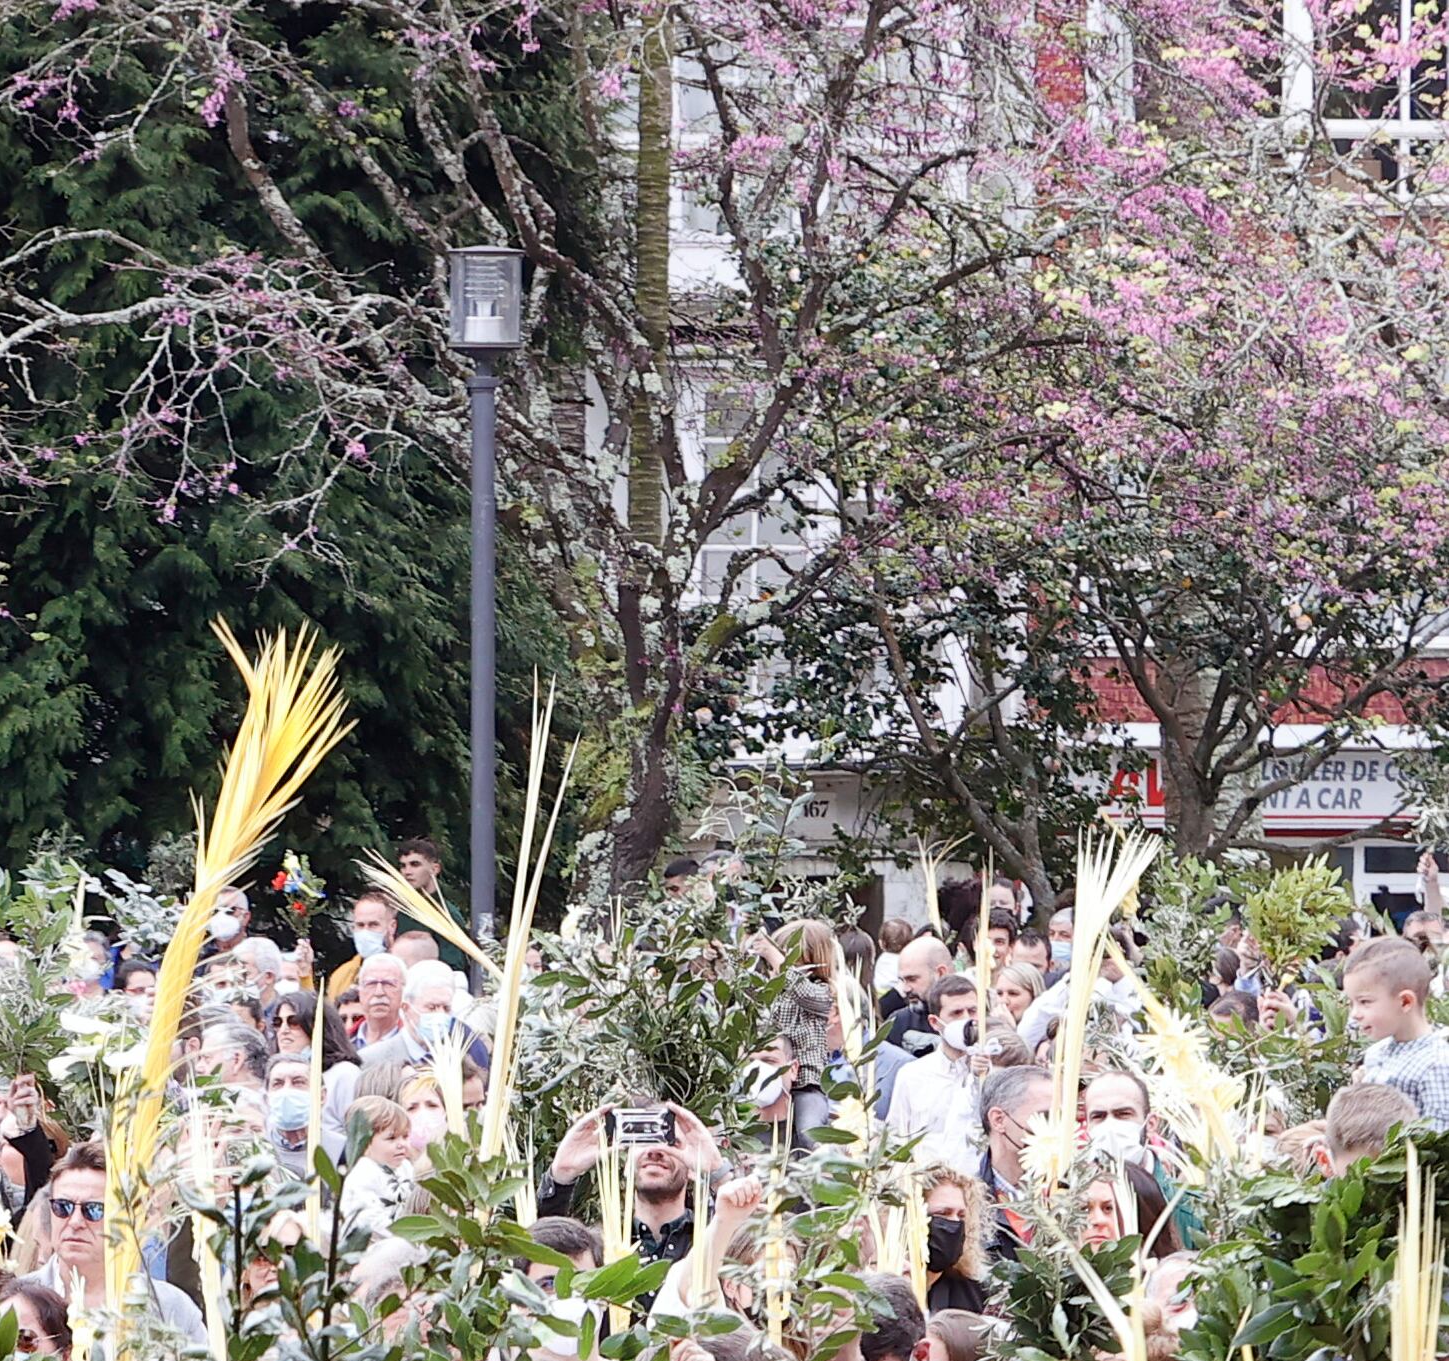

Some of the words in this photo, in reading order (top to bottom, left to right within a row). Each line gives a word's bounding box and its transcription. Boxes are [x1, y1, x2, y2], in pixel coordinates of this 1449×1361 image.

[1352, 760, 1380, 782] DE
[803, 800, 829, 818] 167
[1295, 787, 1311, 809] A
[1317, 787, 1363, 809] CAR
